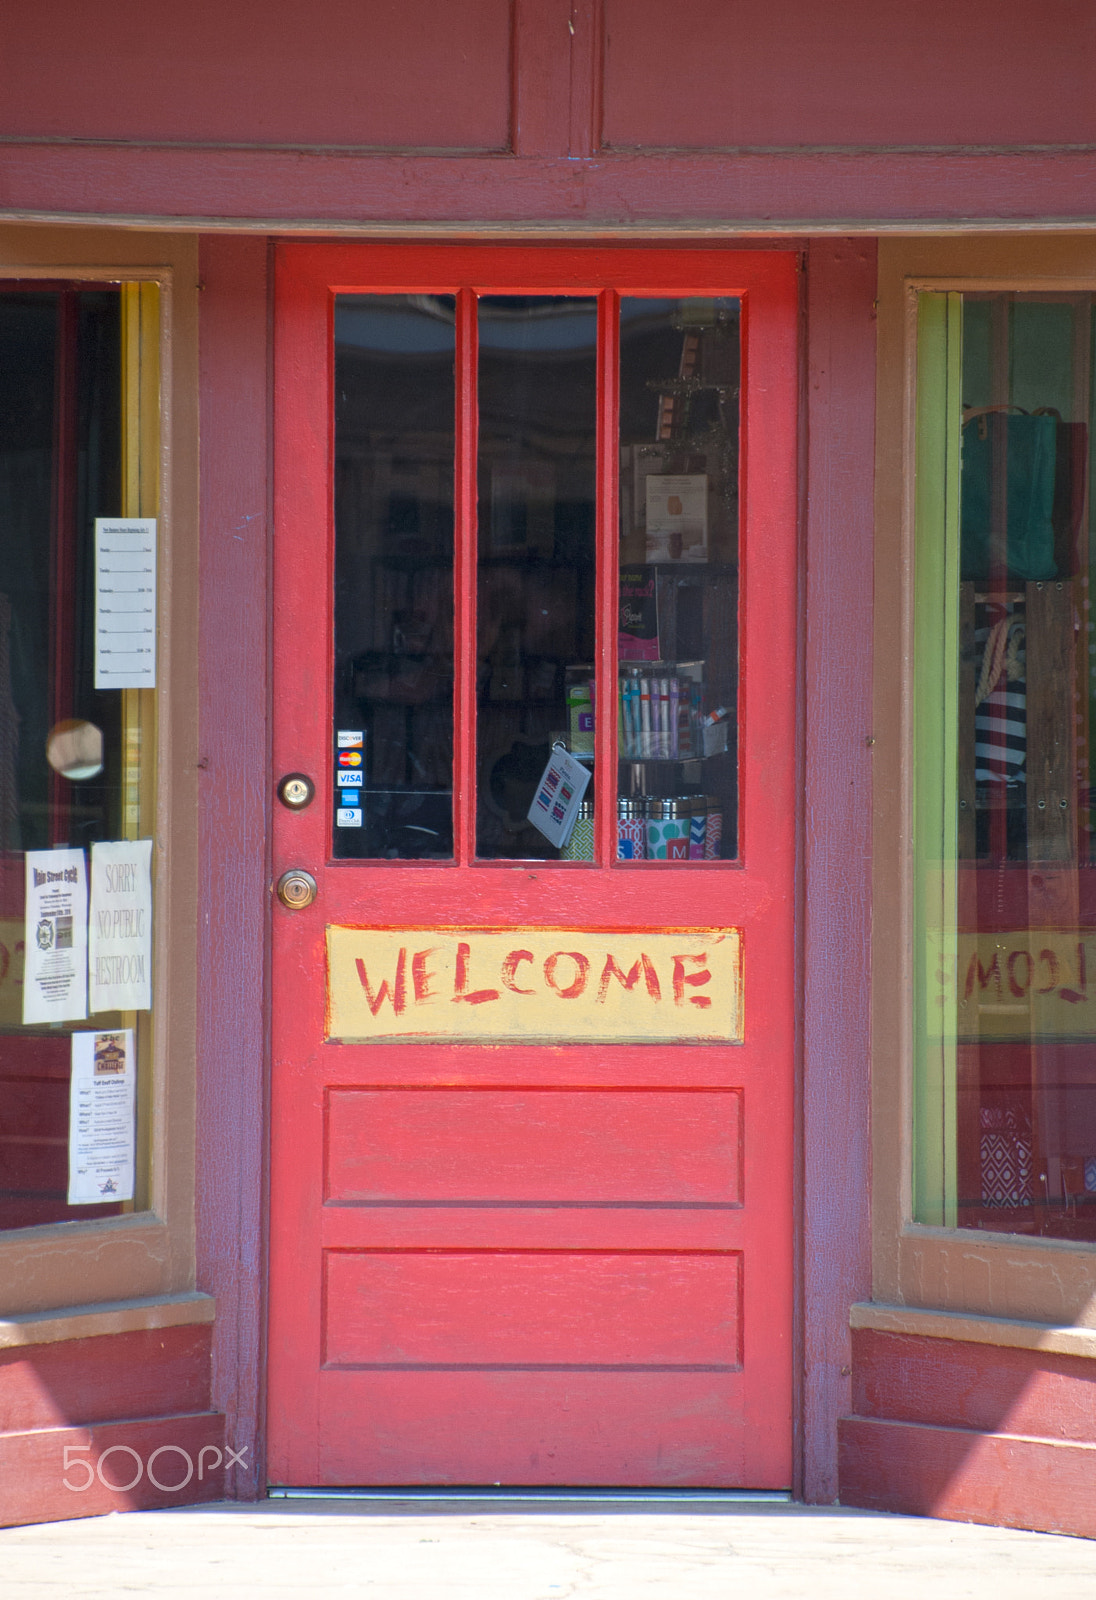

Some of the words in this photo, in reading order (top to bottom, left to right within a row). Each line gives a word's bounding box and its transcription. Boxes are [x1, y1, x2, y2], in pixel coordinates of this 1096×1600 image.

[584, 717, 592, 727] E
[340, 774, 361, 782] VISA
[672, 846, 687, 859] M
[106, 863, 137, 893] SORRY
[97, 910, 111, 939] NO
[113, 908, 144, 938] PUBLIC
[95, 954, 145, 985] RESTROOM
[355, 943, 713, 1017] WELCOME
